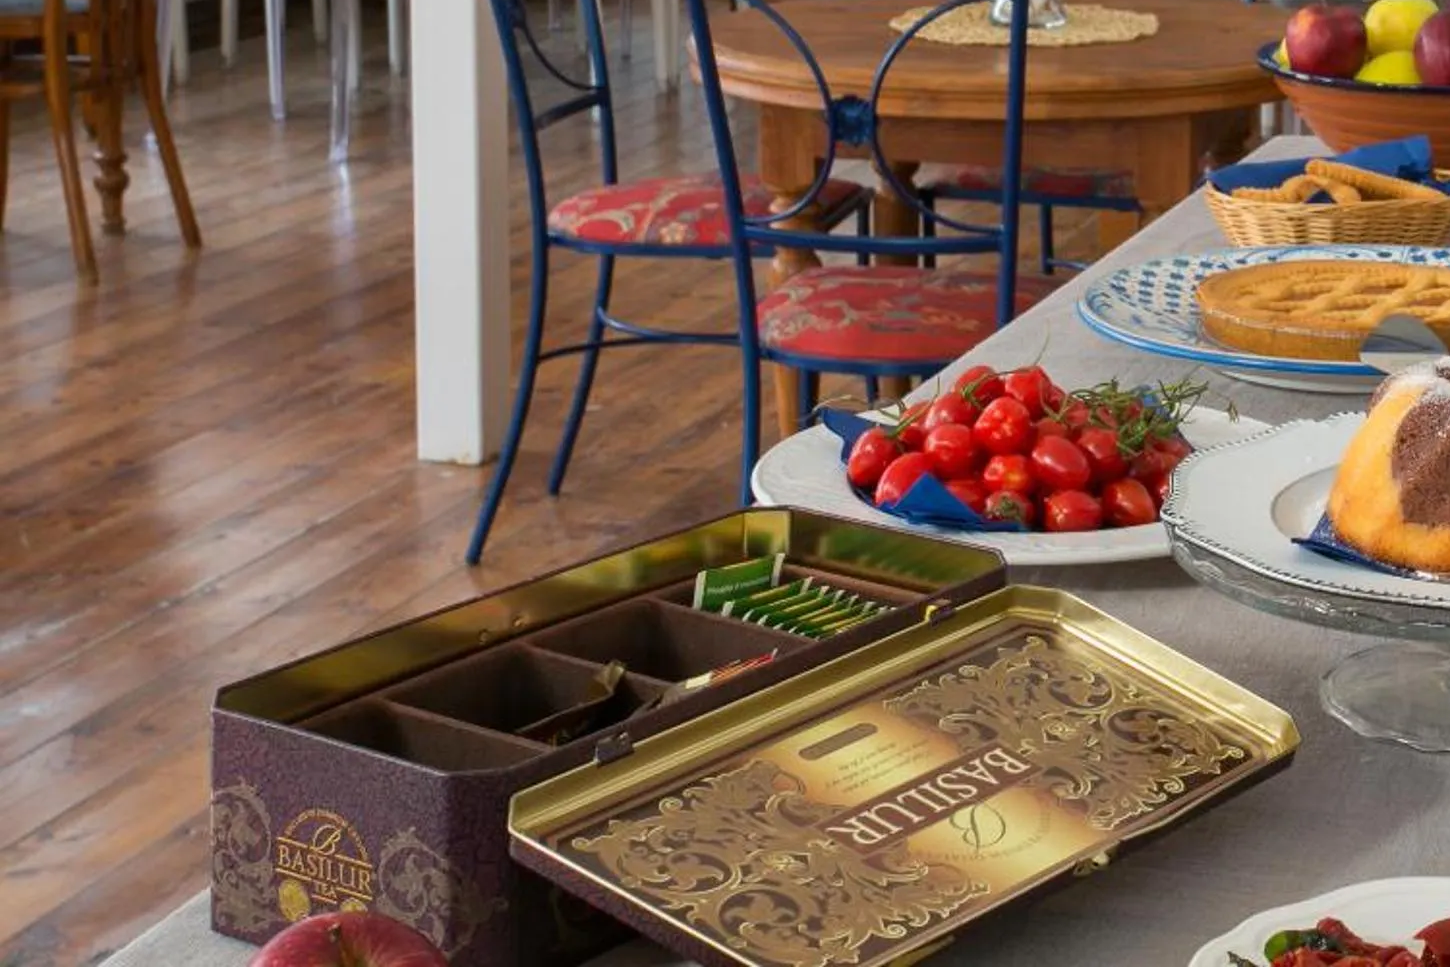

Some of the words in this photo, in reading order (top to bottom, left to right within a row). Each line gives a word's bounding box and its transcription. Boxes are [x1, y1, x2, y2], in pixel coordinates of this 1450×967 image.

[826, 747, 1031, 846] BASILUR
[279, 844, 372, 895] BASILUR
[315, 881, 337, 899] TEA
